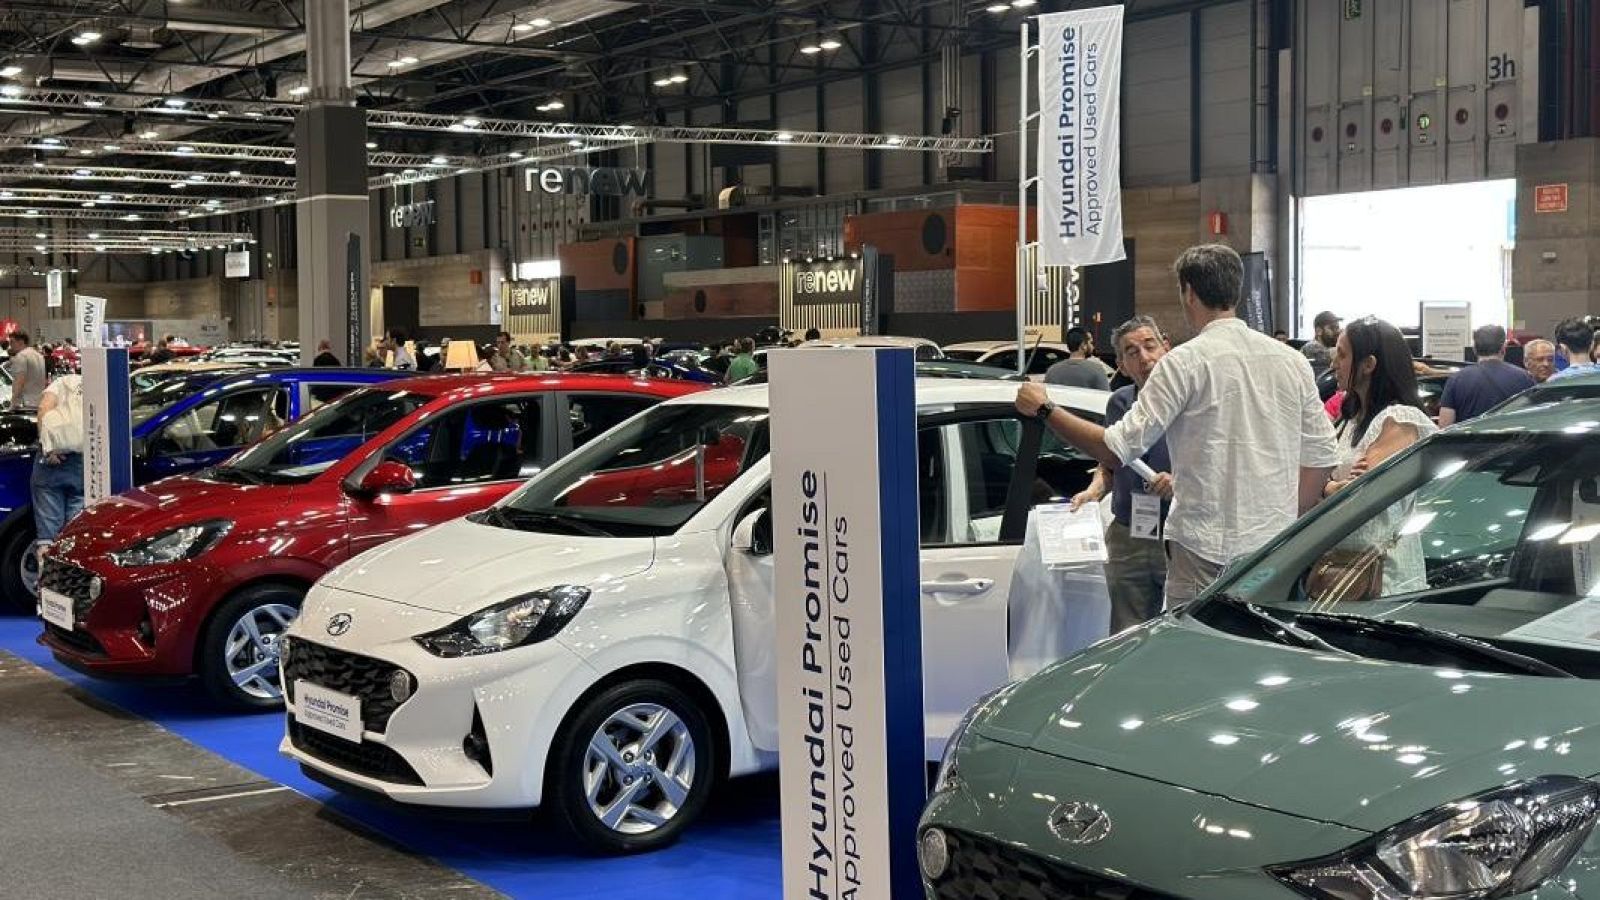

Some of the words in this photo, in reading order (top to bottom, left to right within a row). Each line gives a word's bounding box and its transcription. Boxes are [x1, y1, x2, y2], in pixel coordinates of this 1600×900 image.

[1058, 27, 1075, 128] Promise
[1083, 43, 1097, 86] Cars
[1489, 53, 1515, 79] 3h
[1083, 93, 1097, 140] Used
[525, 167, 646, 195] renew
[1058, 135, 1078, 237] Hyundai
[1086, 147, 1102, 235] Approved
[511, 287, 549, 307] renew
[796, 269, 856, 294] renew
[798, 470, 823, 674] Promise
[833, 516, 849, 604] Cars
[833, 615, 853, 711] Used
[803, 687, 832, 900] Hyundai
[836, 724, 861, 900] Approved
